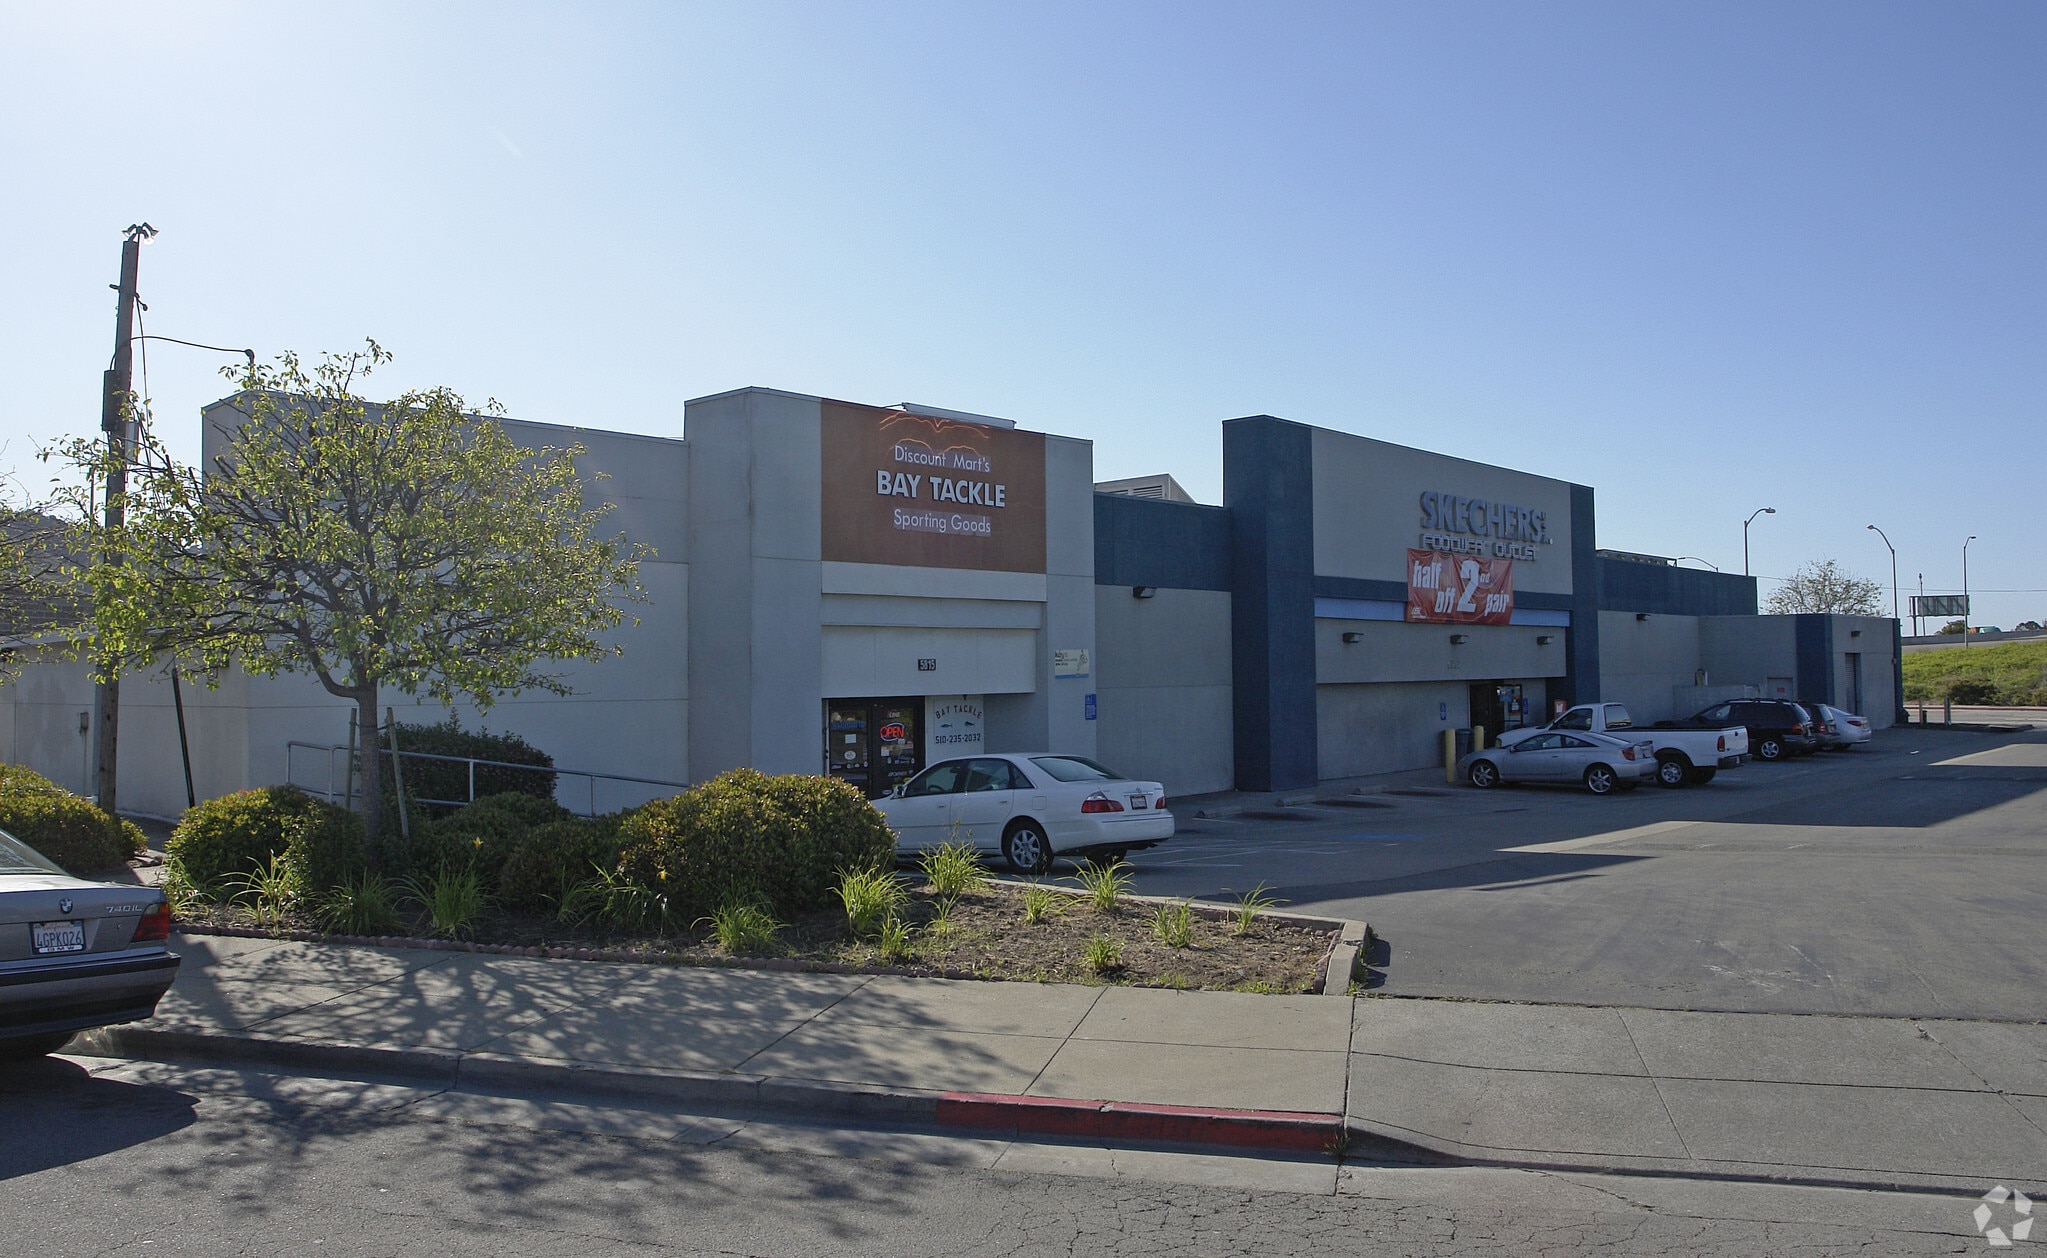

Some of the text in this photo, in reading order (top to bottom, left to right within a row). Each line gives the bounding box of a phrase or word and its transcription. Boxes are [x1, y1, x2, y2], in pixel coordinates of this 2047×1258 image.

[894, 445, 990, 473] Discount Mart's
[877, 469, 1006, 508] BAY TACKLE
[893, 508, 991, 534] Sporting Goods
[1420, 490, 1542, 544] SKECHERS
[1412, 560, 1442, 590] half
[1434, 587, 1456, 614] off
[1485, 591, 1510, 616] pair
[953, 704, 983, 719] TACKLE
[880, 725, 905, 738] OPEN
[36, 931, 82, 948] 4GPK026
